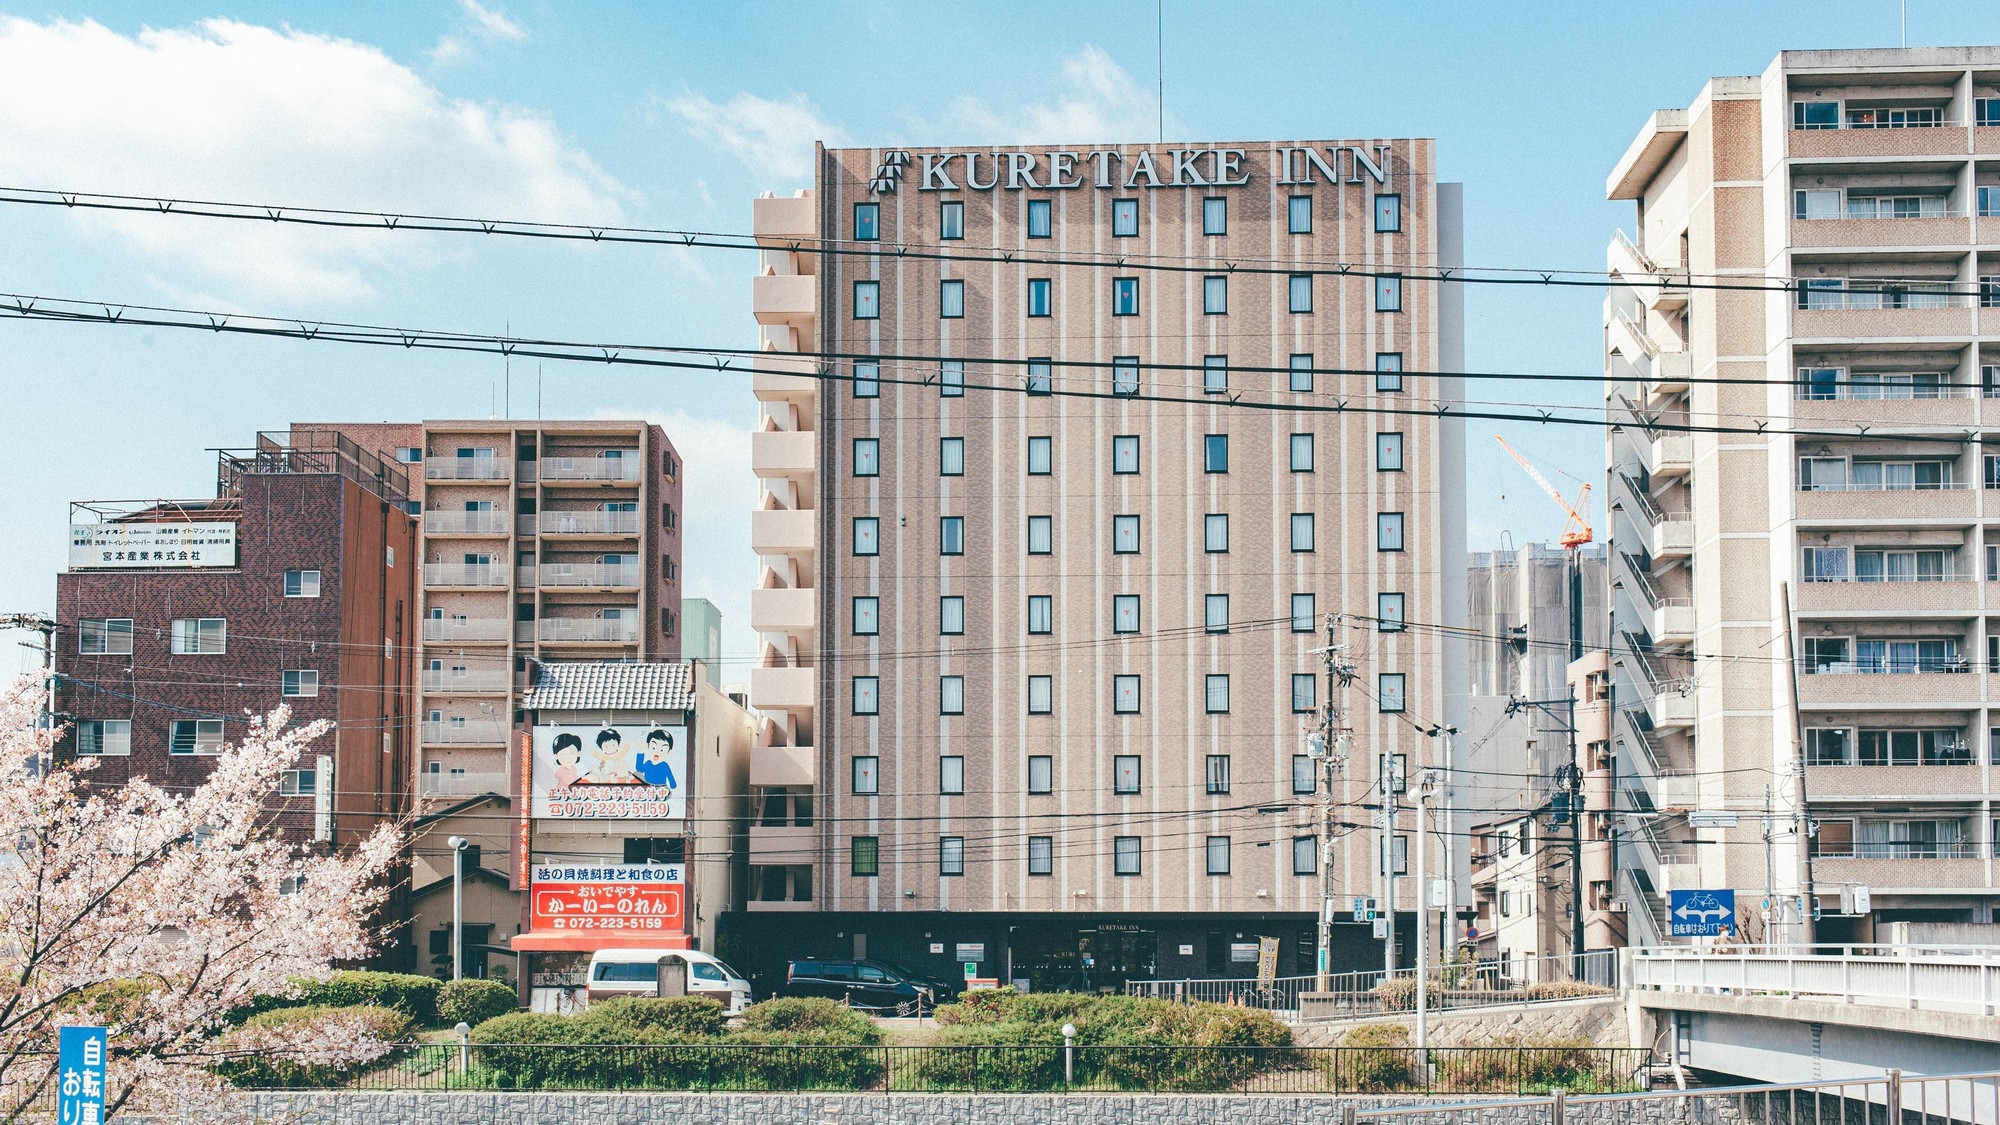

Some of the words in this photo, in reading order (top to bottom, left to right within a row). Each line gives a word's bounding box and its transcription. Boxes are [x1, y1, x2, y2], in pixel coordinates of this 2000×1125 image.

[918, 149, 1251, 191] KURETAKE
[1276, 145, 1392, 186] INN
[102, 550, 201, 562] 宮本産業株式会社
[547, 787, 670, 801] 正午より電話予約受付中
[565, 802, 669, 816] 072-223-5159
[538, 868, 678, 881] 活の貝焼料理と和食の店
[577, 885, 639, 898] おいでやす
[569, 917, 662, 929] 072-223-5159
[81, 1035, 101, 1125] 自転車
[62, 1066, 81, 1125] おり
